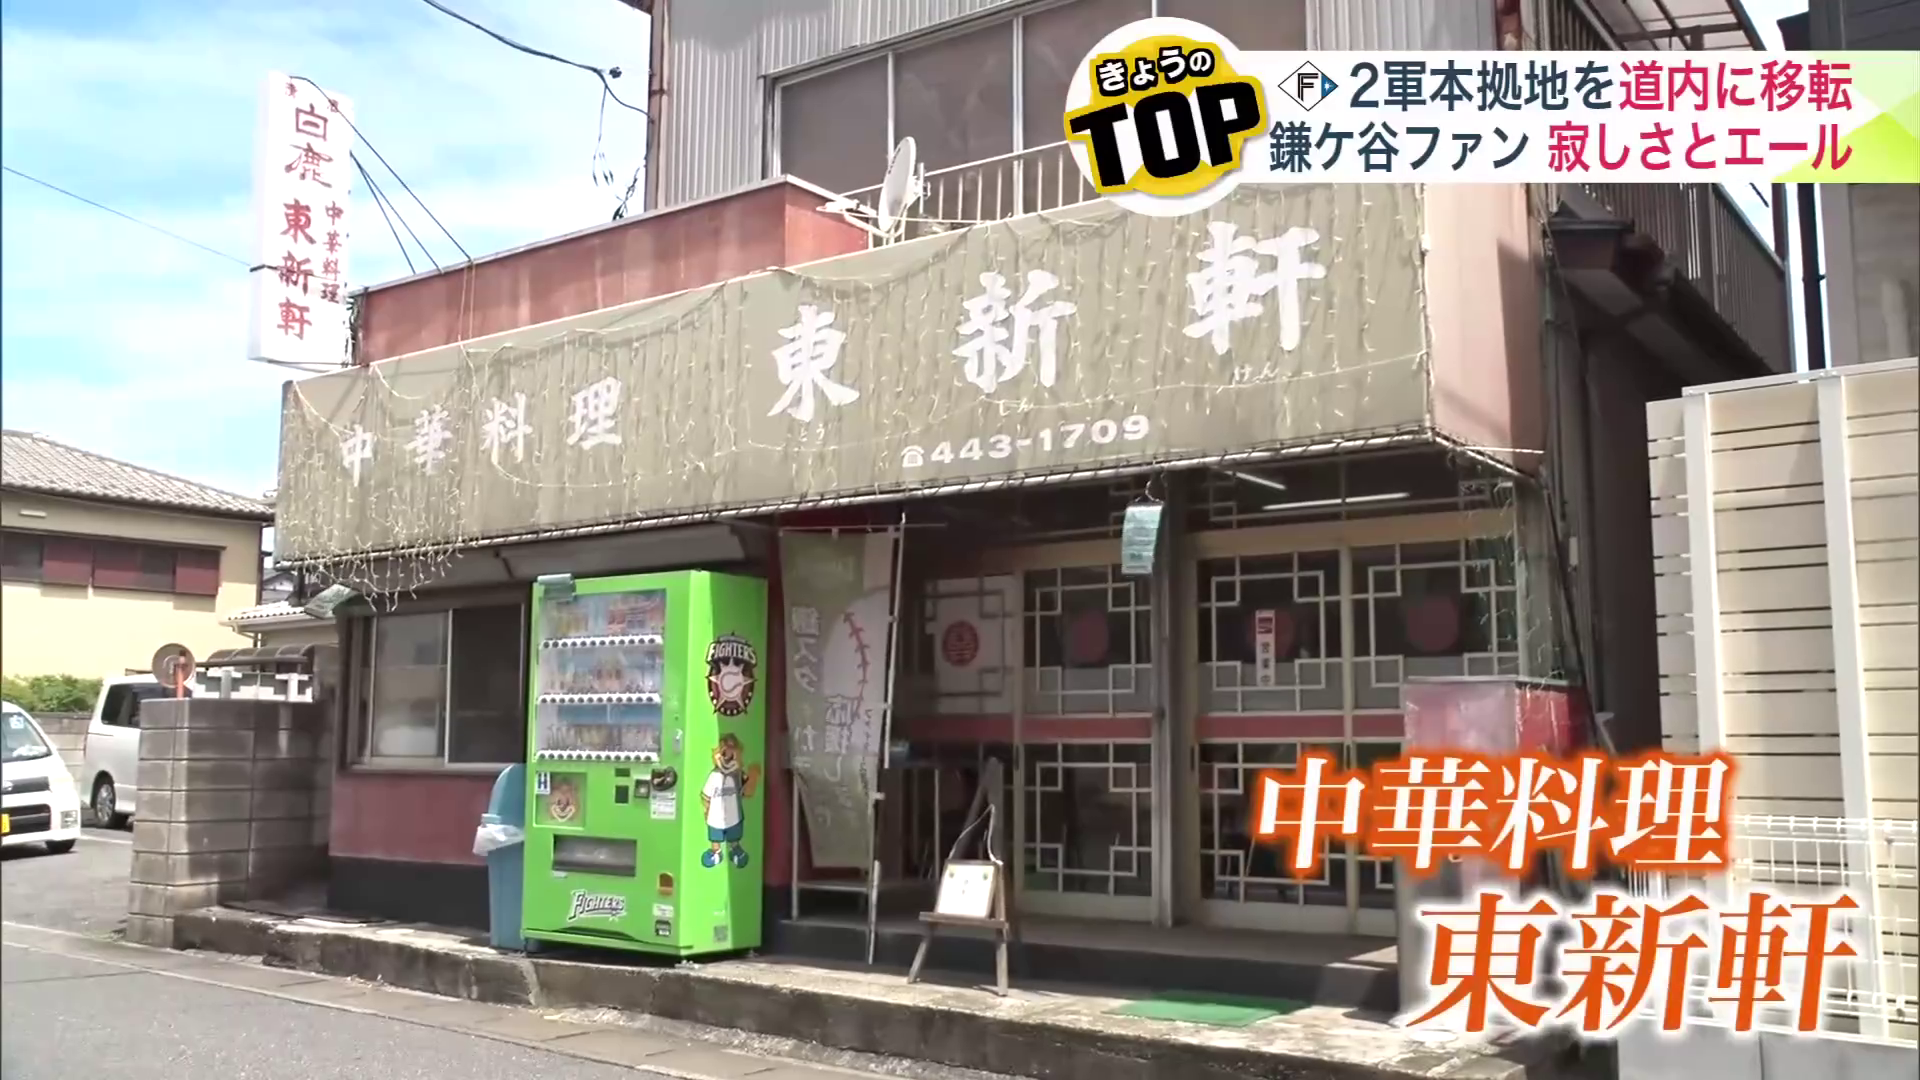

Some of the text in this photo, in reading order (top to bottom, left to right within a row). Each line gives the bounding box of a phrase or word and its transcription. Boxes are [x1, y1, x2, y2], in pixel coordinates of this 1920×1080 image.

[276, 198, 317, 341] 東新軒
[320, 201, 344, 305] 中華料理
[339, 220, 1328, 488] 中華料理 東新軒
[930, 414, 1150, 464] 443-1709
[707, 641, 757, 665] FIGHTERS
